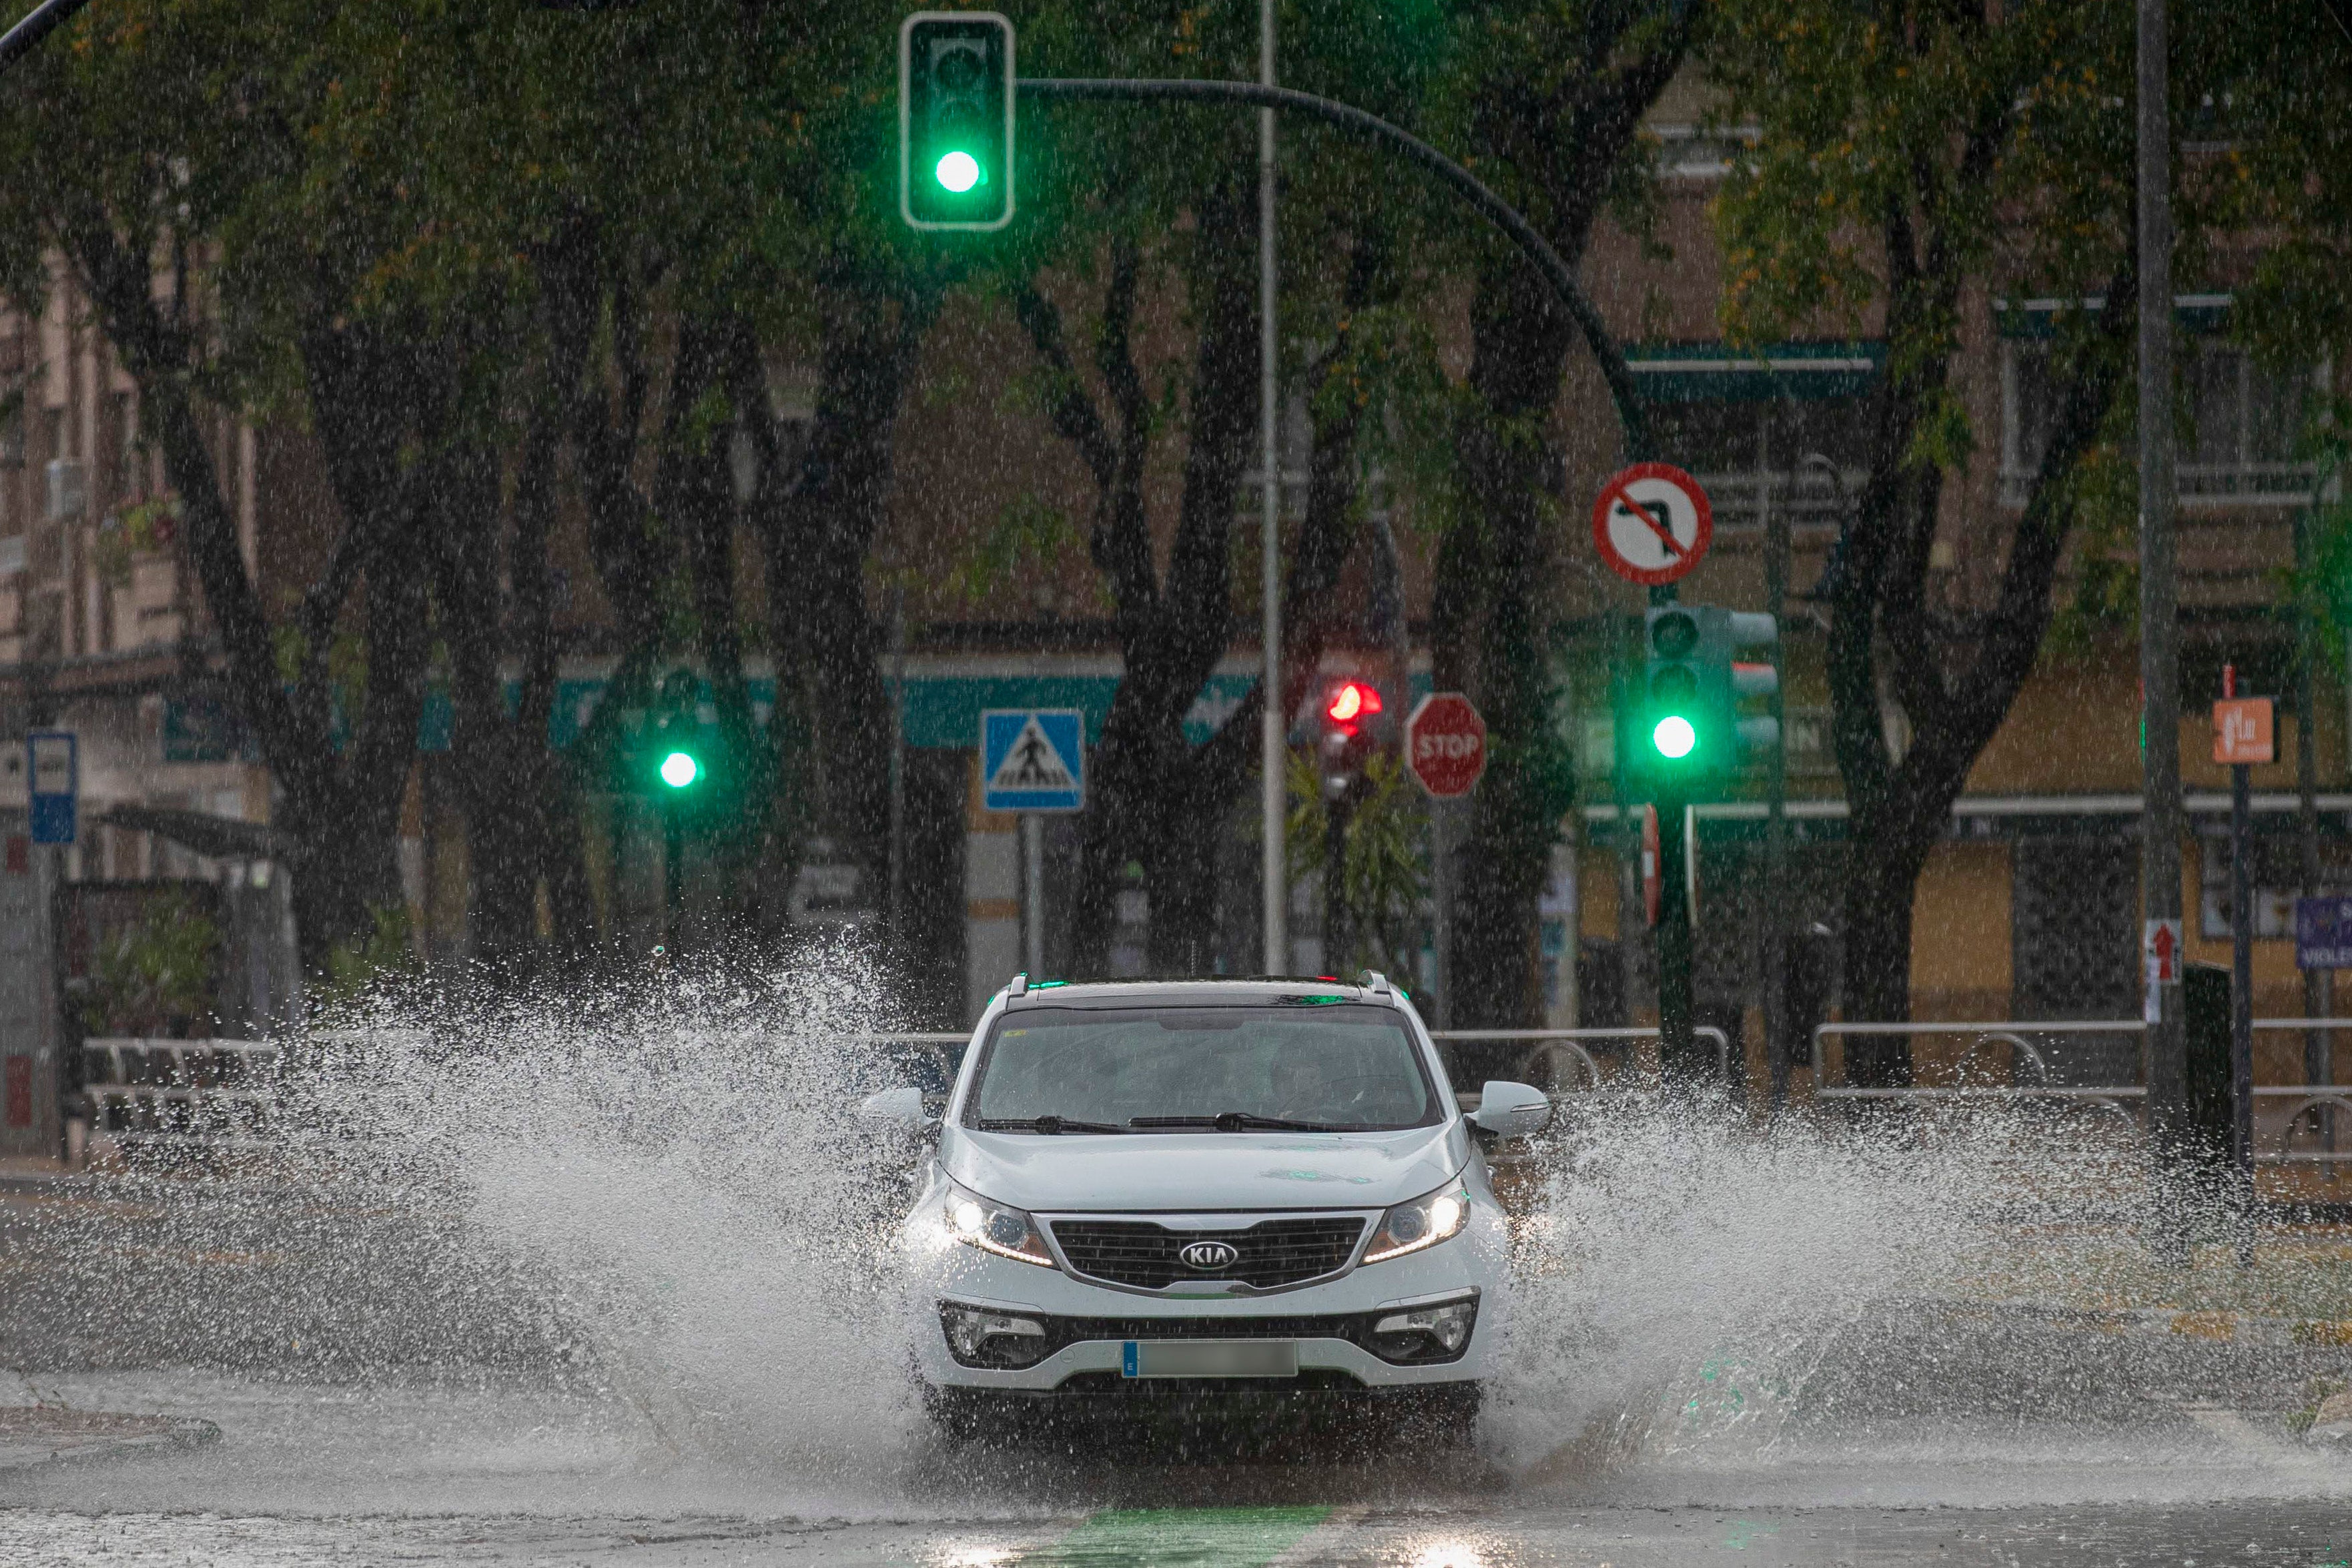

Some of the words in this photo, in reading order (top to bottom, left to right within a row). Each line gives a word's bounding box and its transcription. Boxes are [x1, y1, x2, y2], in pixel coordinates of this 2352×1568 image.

[1419, 734, 1479, 759] STOP
[1190, 1247, 1228, 1263] KIA
[1128, 1362, 1133, 1370] E
